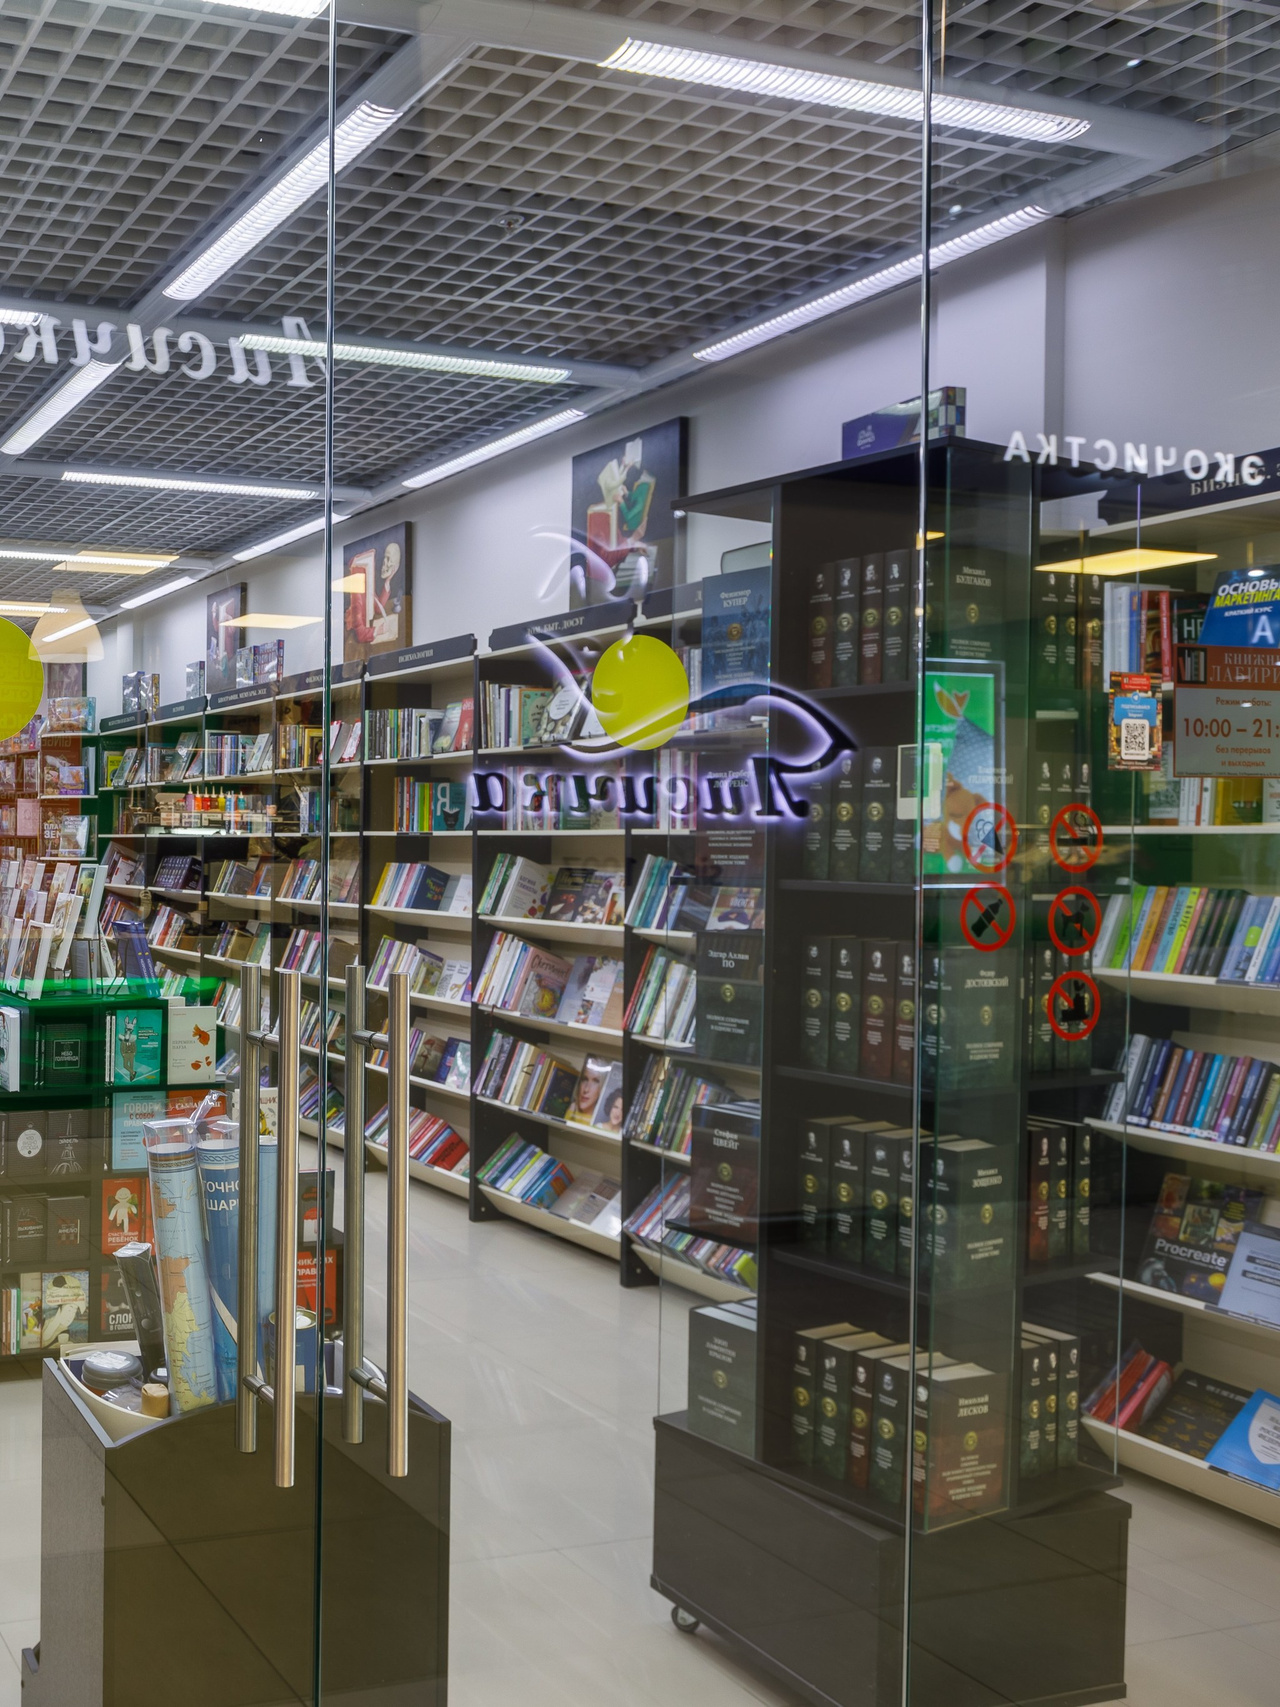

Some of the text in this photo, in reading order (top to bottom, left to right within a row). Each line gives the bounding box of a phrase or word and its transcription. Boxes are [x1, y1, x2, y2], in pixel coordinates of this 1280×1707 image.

[962, 566, 986, 576] Михаил
[956, 574, 992, 587] БУЛГАКОВ
[720, 589, 751, 600] Фенимор
[723, 597, 748, 608] КУПЕР
[1254, 606, 1274, 614] КУРС
[399, 649, 434, 663] ПСИХОЛОГИЯ
[1216, 697, 1240, 706] Режим
[1184, 718, 1231, 738] 10:00
[1253, 718, 1280, 738] 21:
[1216, 745, 1271, 756] без перерывов
[722, 959, 735, 968] ПО
[964, 976, 1009, 989] ДОСТОЕВСКИЙ
[712, 1137, 740, 1150] ЦВЕЙГ
[971, 1175, 1003, 1188] ЗОЩЕНКО
[1155, 1238, 1228, 1267] Procreate
[958, 1394, 990, 1407] Николай
[957, 1405, 989, 1418] ЛЕСКОВ
